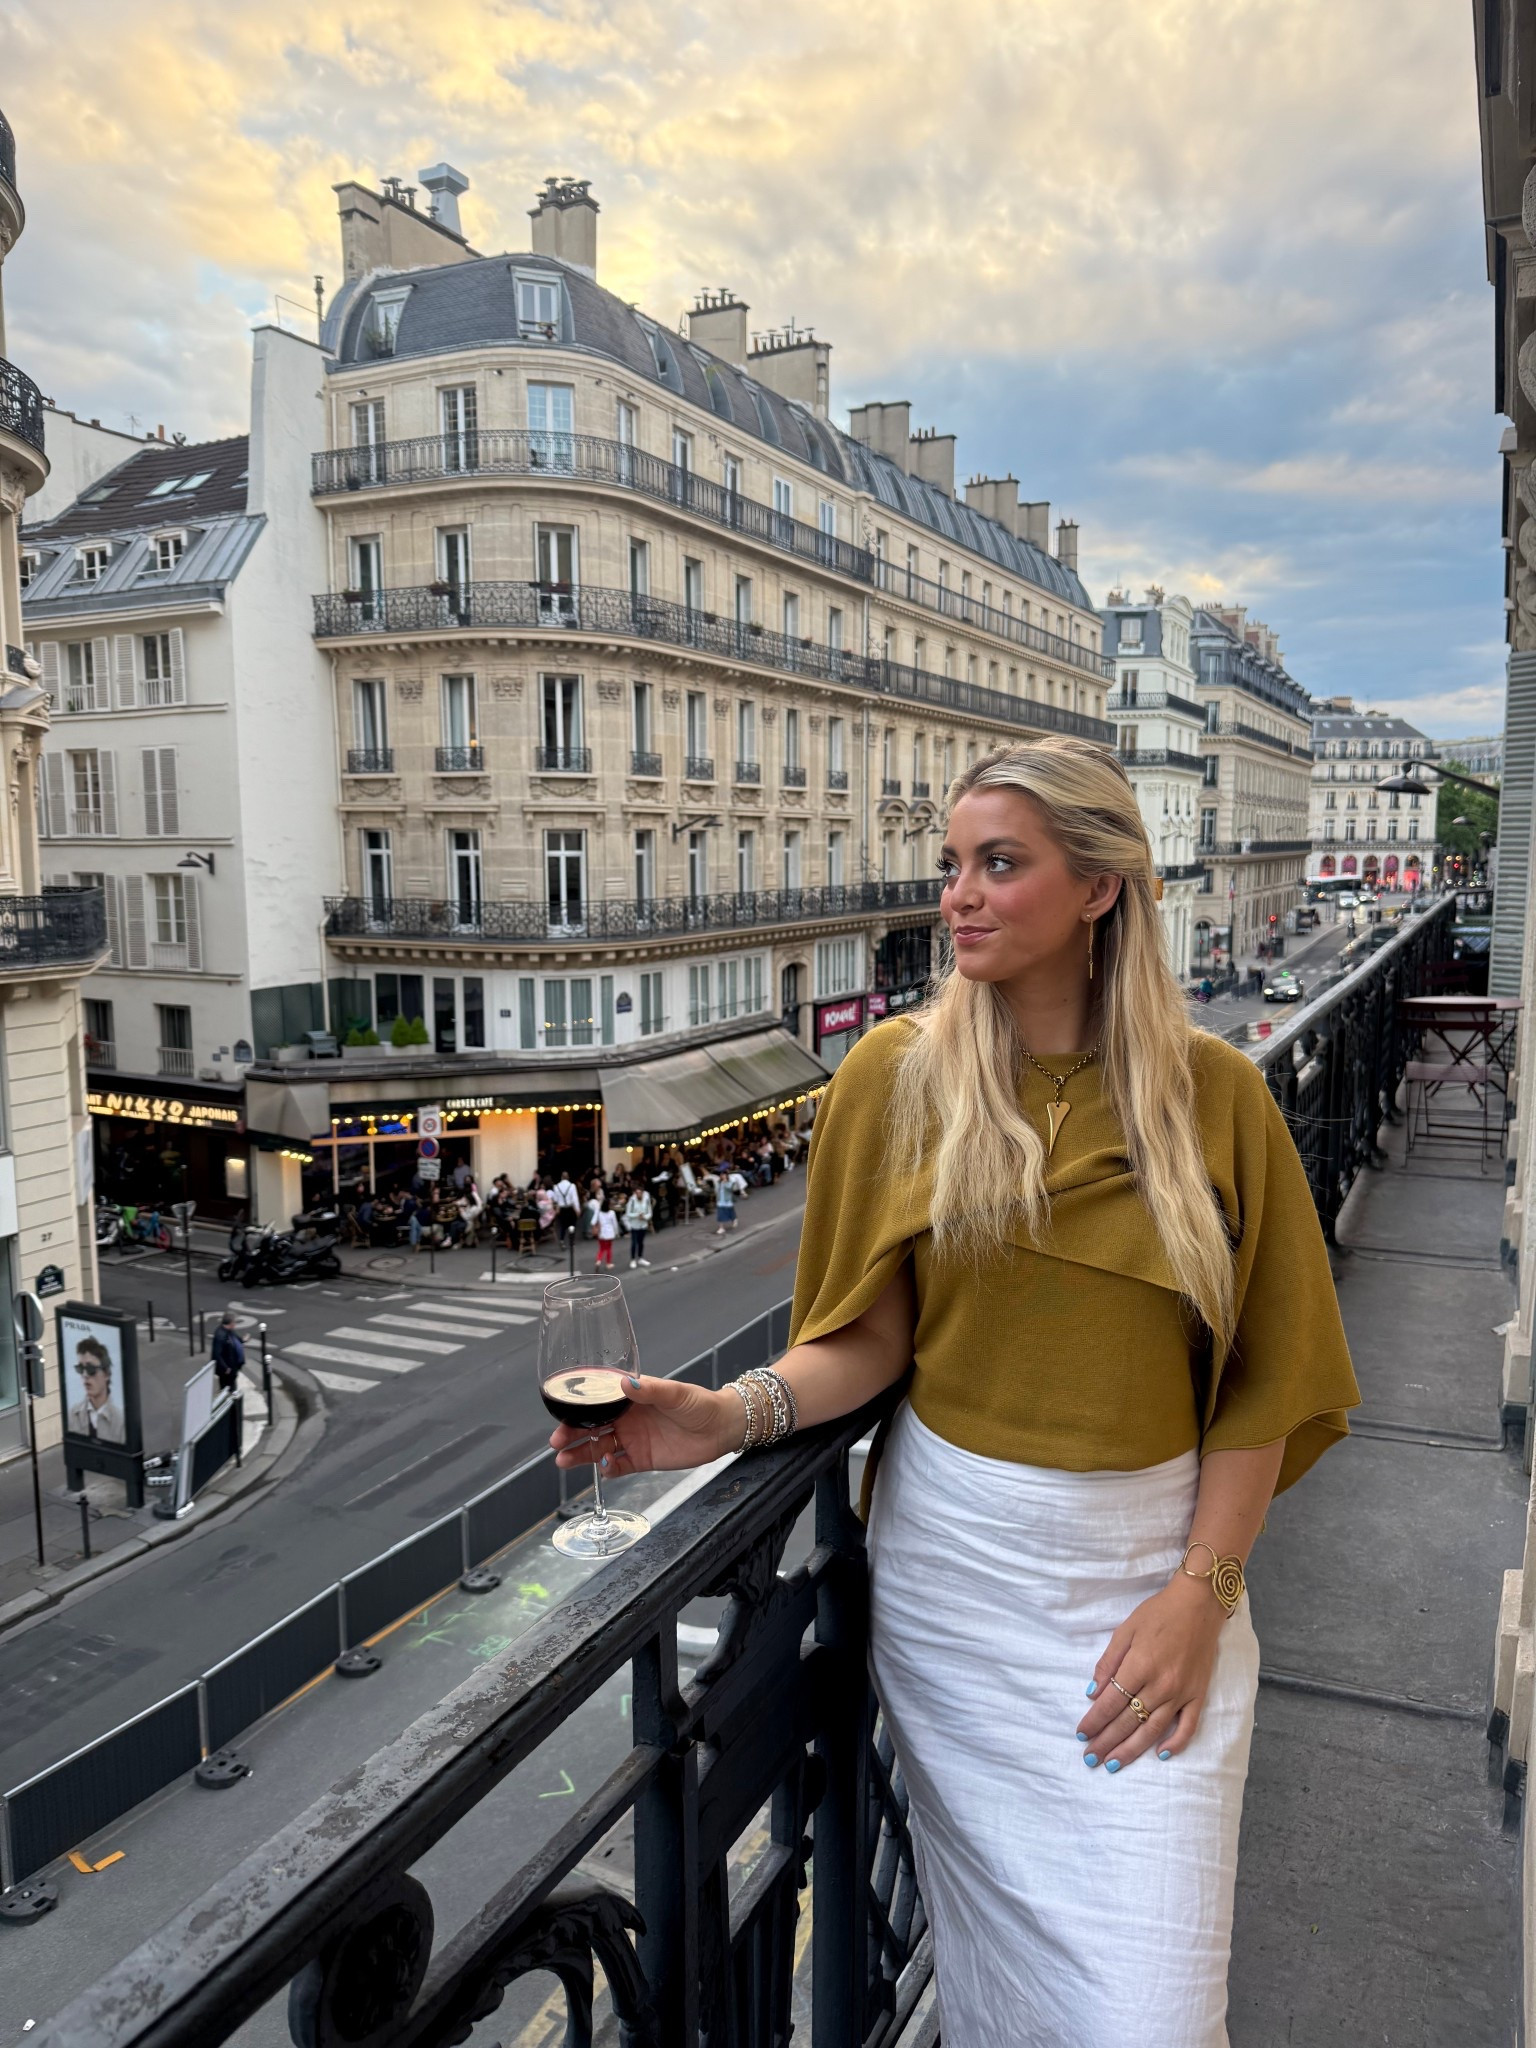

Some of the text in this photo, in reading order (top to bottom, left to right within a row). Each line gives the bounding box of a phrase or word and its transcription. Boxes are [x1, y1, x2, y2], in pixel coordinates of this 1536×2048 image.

[106, 1092, 184, 1117] NIKKO
[189, 1105, 238, 1122] JAPONAIS
[446, 1098, 476, 1109] CORNER
[41, 1232, 52, 1242] 27
[64, 1321, 91, 1331] PRADA
